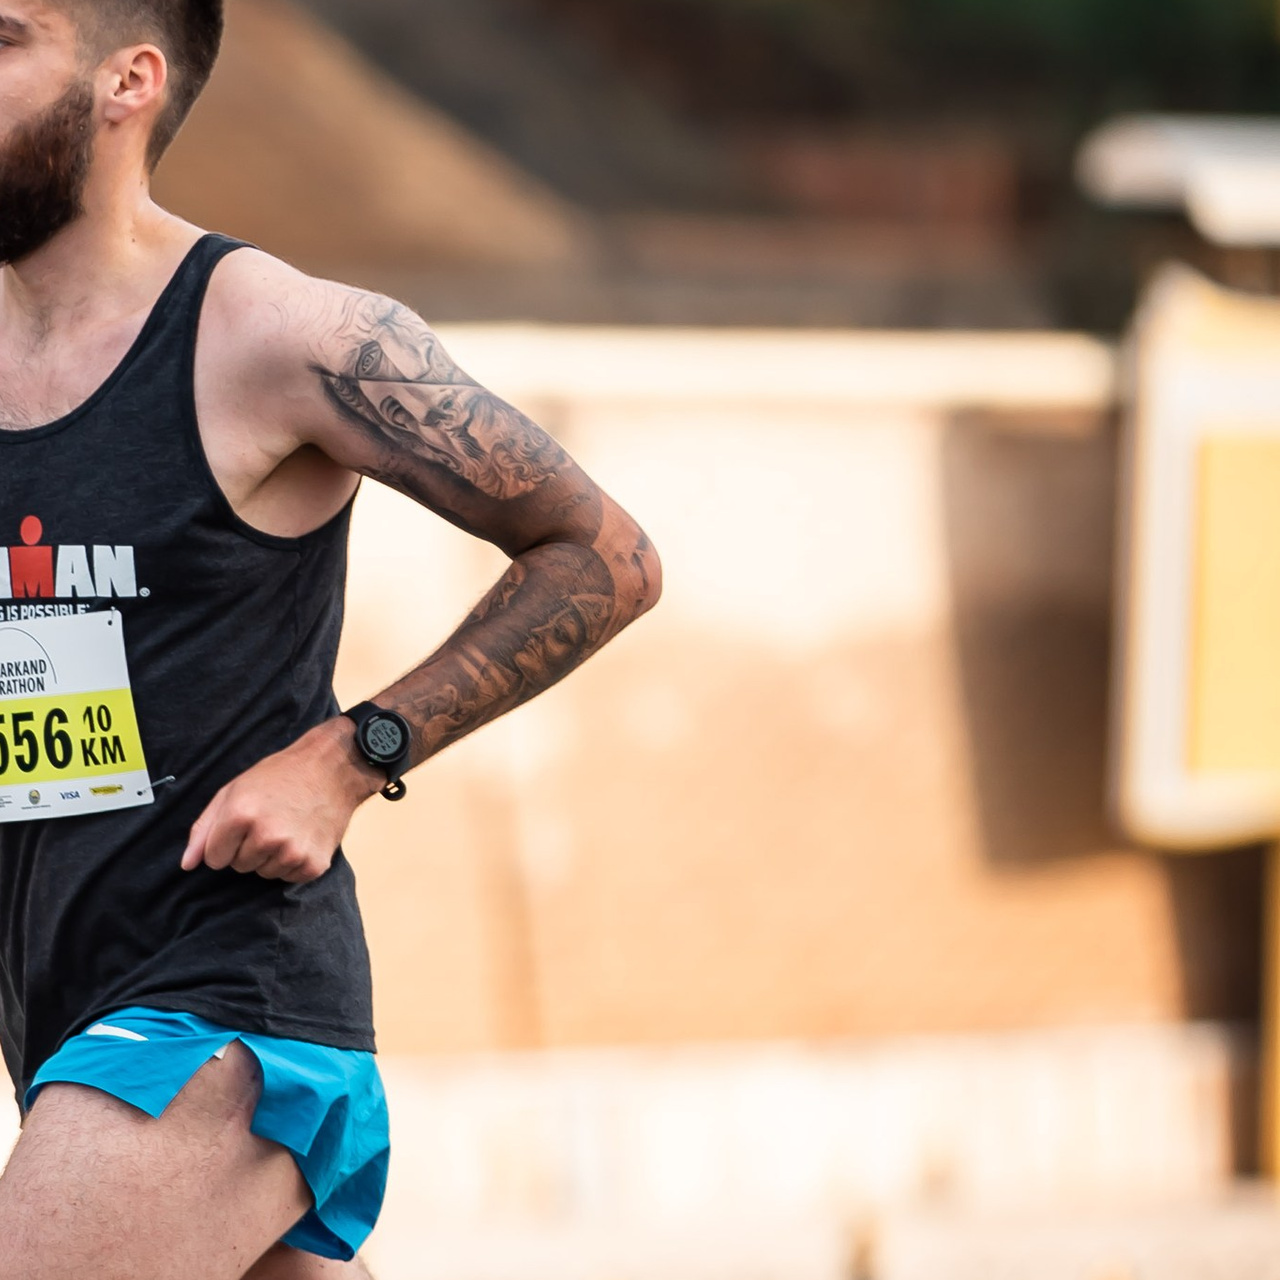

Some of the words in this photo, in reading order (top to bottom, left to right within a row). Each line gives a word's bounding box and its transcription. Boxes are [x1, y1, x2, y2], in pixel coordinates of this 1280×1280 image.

[7, 605, 19, 621] IS
[83, 704, 112, 733] 10
[80, 735, 126, 767] KM
